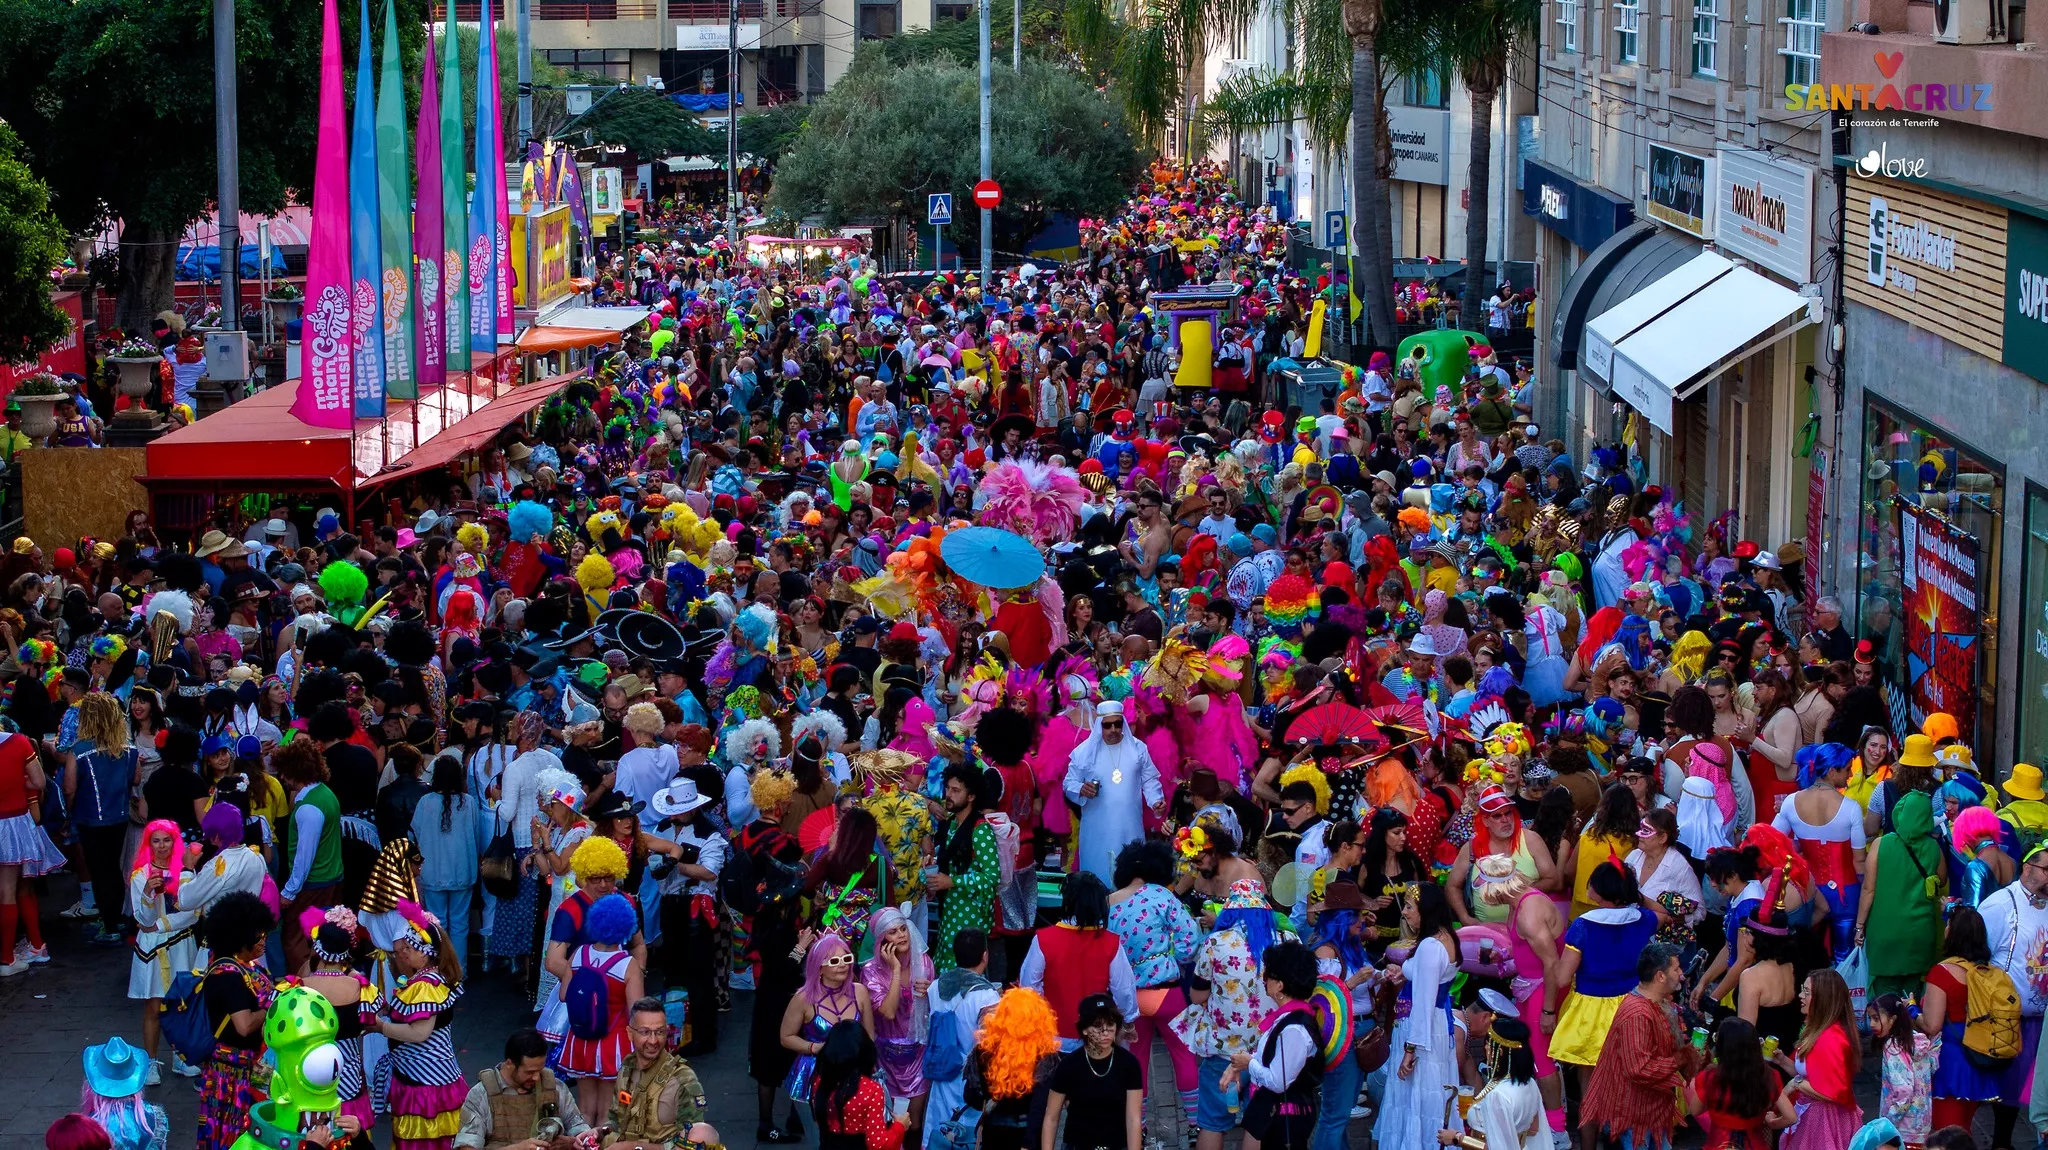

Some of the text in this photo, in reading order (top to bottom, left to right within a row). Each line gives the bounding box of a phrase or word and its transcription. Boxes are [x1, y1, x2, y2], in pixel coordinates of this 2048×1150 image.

[1392, 148, 1439, 163] uropea CANARIAS
[1330, 214, 1344, 243] P
[497, 267, 509, 318] music
[396, 321, 410, 381] music
[450, 299, 460, 354] music
[311, 355, 327, 410] more
[324, 356, 340, 410] than
[338, 343, 351, 409] music
[364, 335, 383, 399] music
[62, 422, 86, 433] USA
